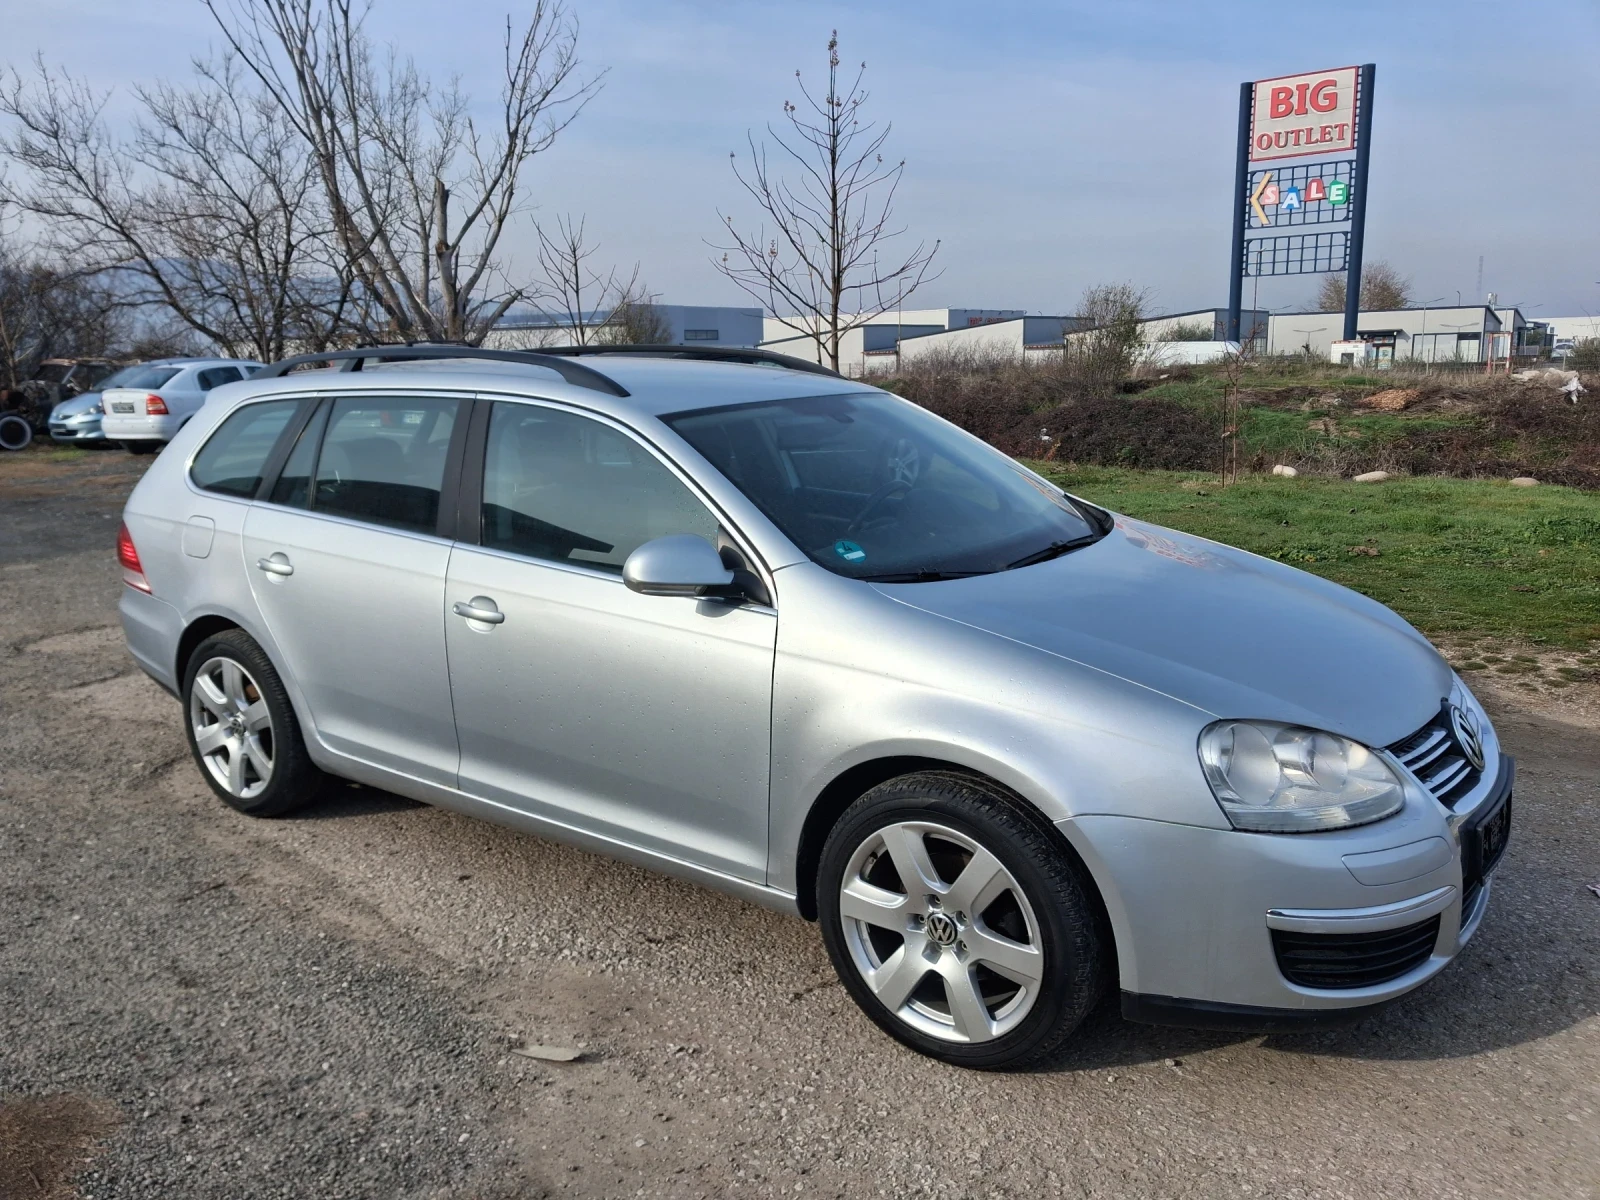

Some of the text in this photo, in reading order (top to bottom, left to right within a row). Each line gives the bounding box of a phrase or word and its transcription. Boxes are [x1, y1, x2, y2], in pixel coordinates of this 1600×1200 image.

[1270, 79, 1338, 118] BIG
[1256, 123, 1349, 150] OUTLET
[1263, 181, 1346, 209] SALE
